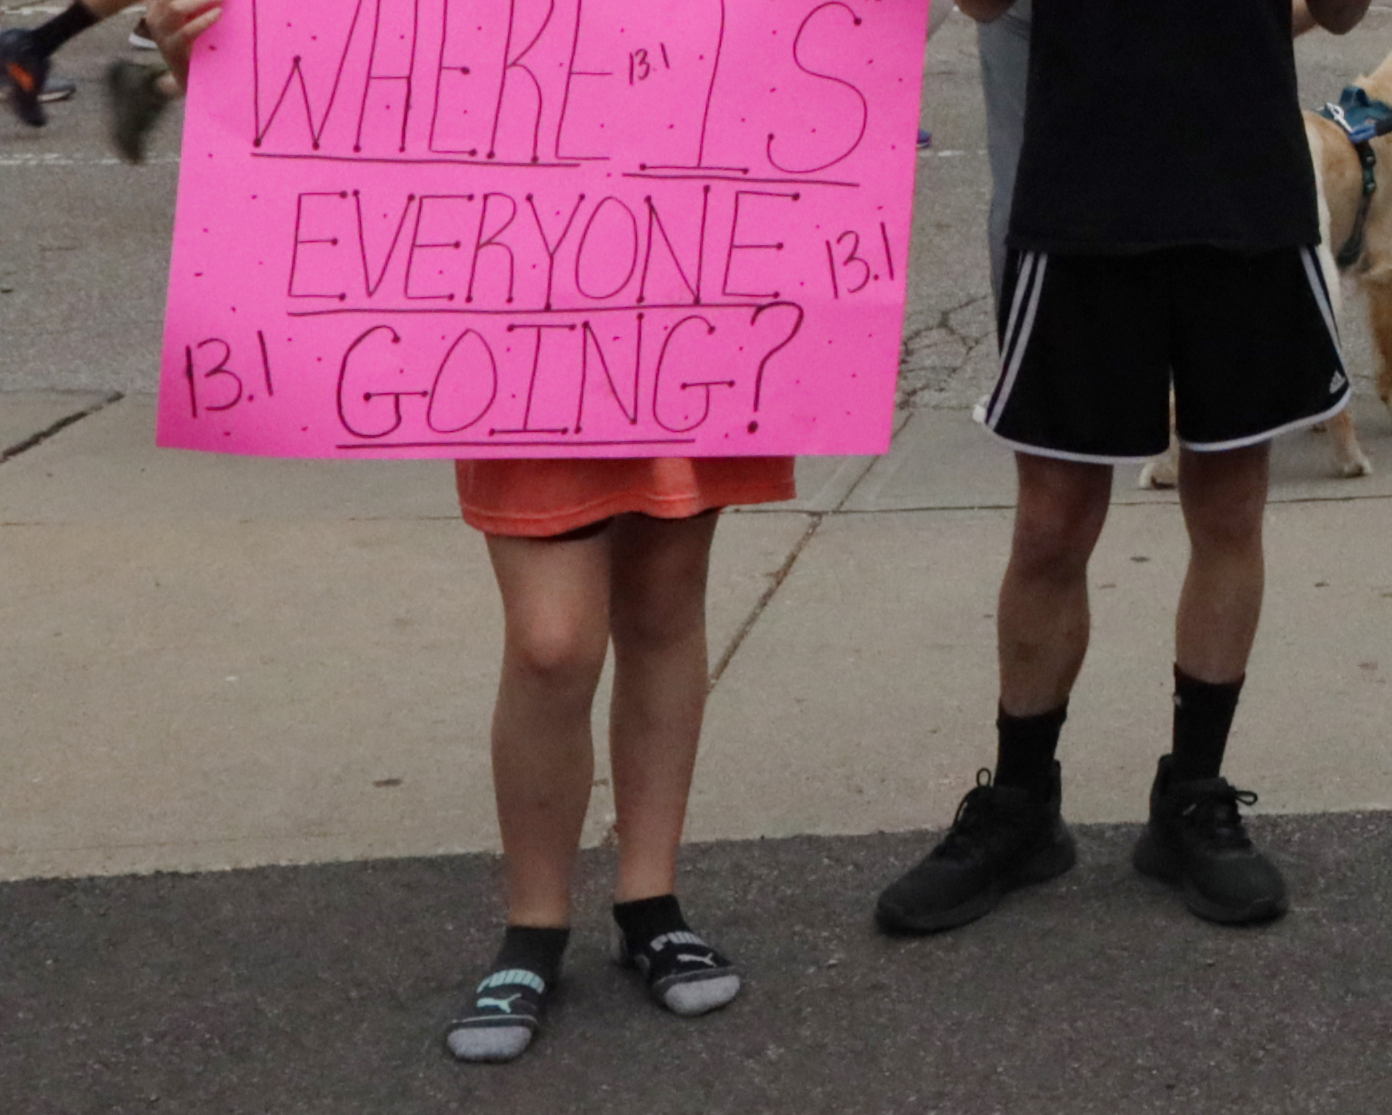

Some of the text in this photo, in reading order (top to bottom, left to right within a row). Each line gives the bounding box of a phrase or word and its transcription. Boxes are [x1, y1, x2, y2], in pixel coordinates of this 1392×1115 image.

[628, 42, 671, 86] 13.1
[287, 184, 802, 312] EVERYONE
[825, 221, 896, 299] 13.1
[184, 331, 274, 419] 13.1
[335, 300, 805, 440] GOING?
